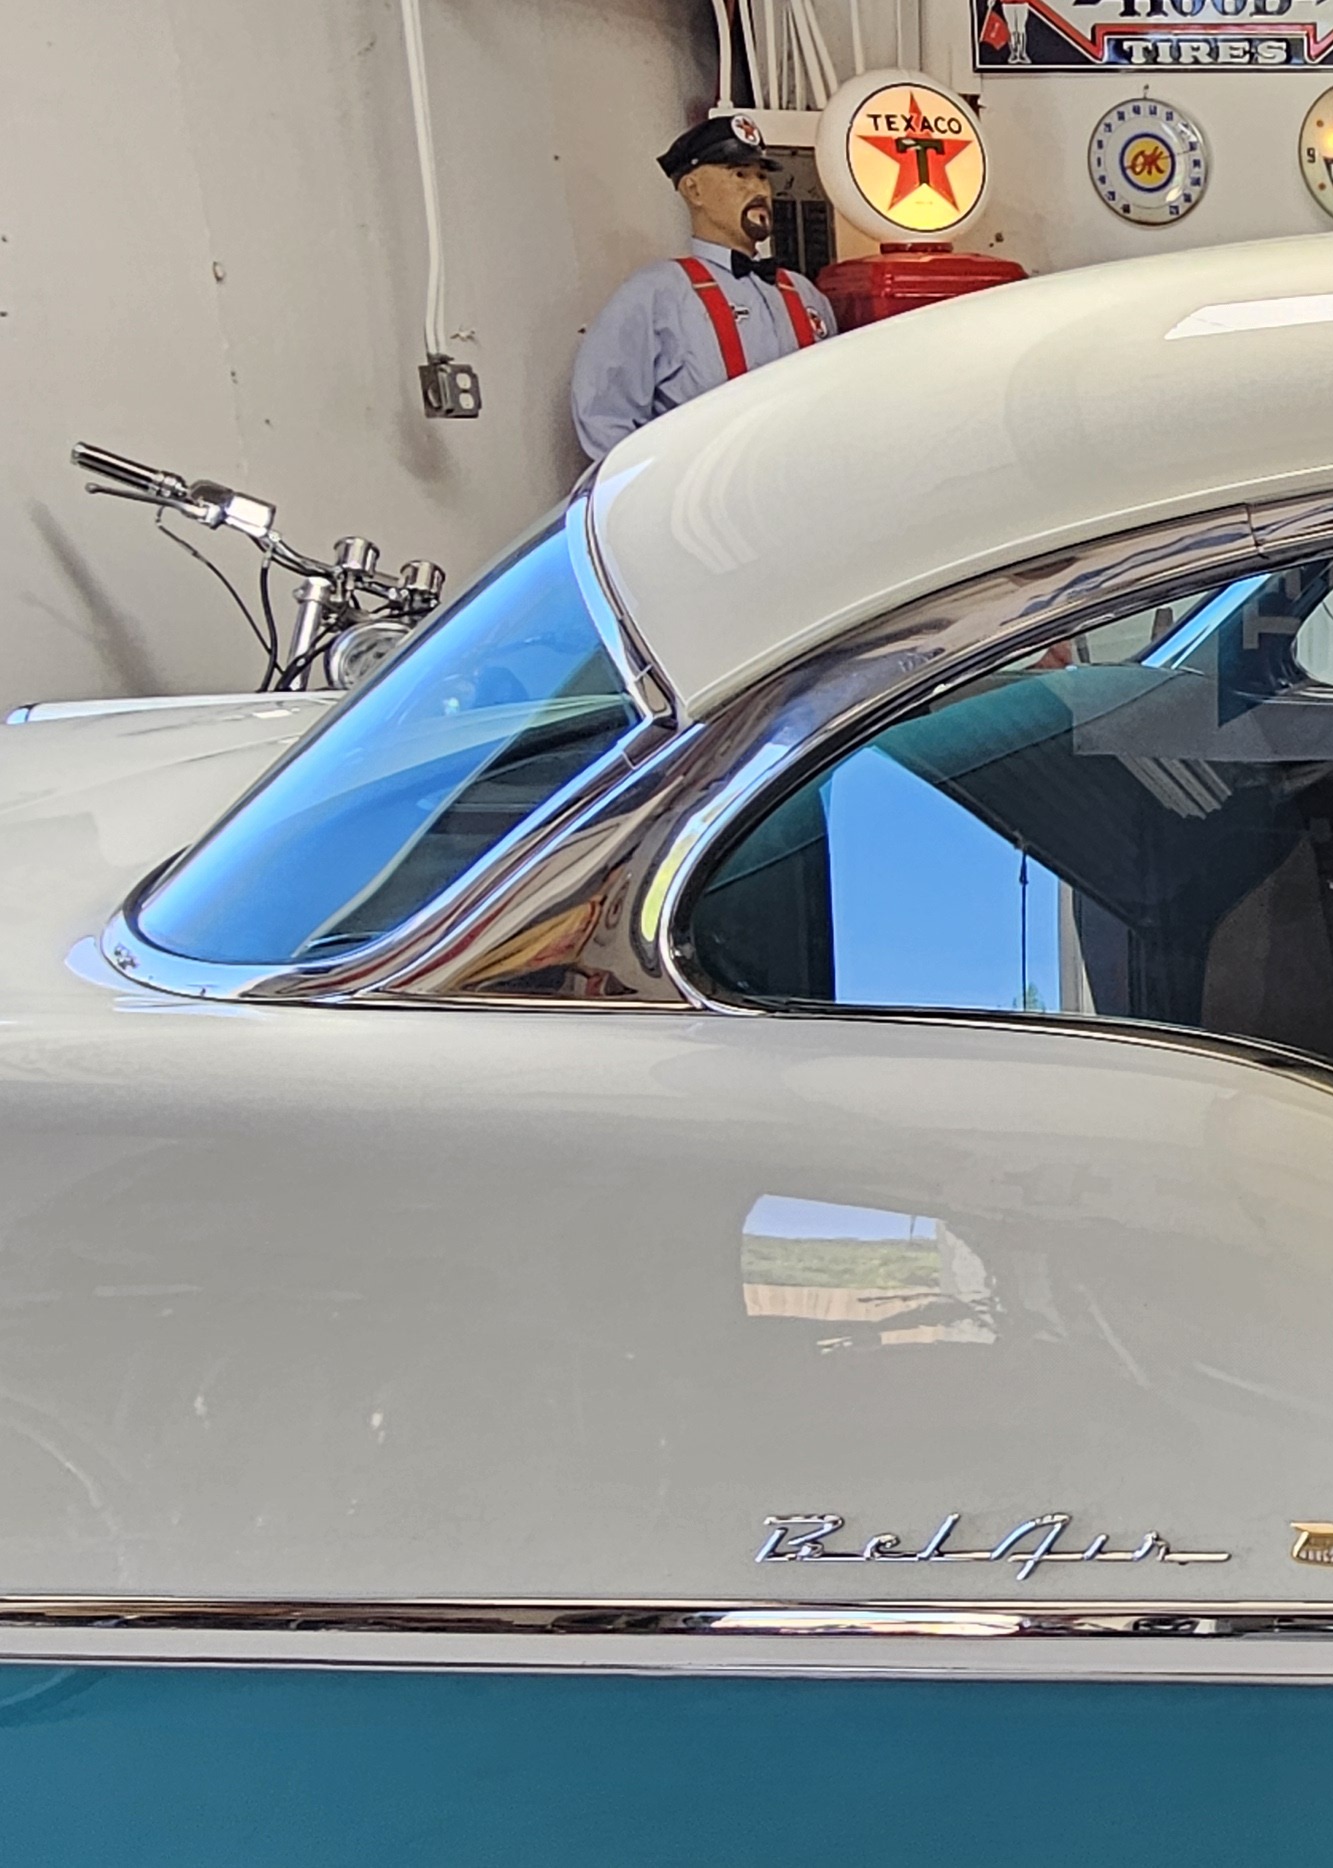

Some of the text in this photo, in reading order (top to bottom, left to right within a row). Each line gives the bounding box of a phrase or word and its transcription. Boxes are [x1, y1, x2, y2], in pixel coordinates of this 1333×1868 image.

[1123, 41, 1286, 64] TIRES
[867, 113, 962, 135] TEXACO
[1131, 146, 1165, 176] OK
[755, 1513, 1231, 1580] Bel Air
